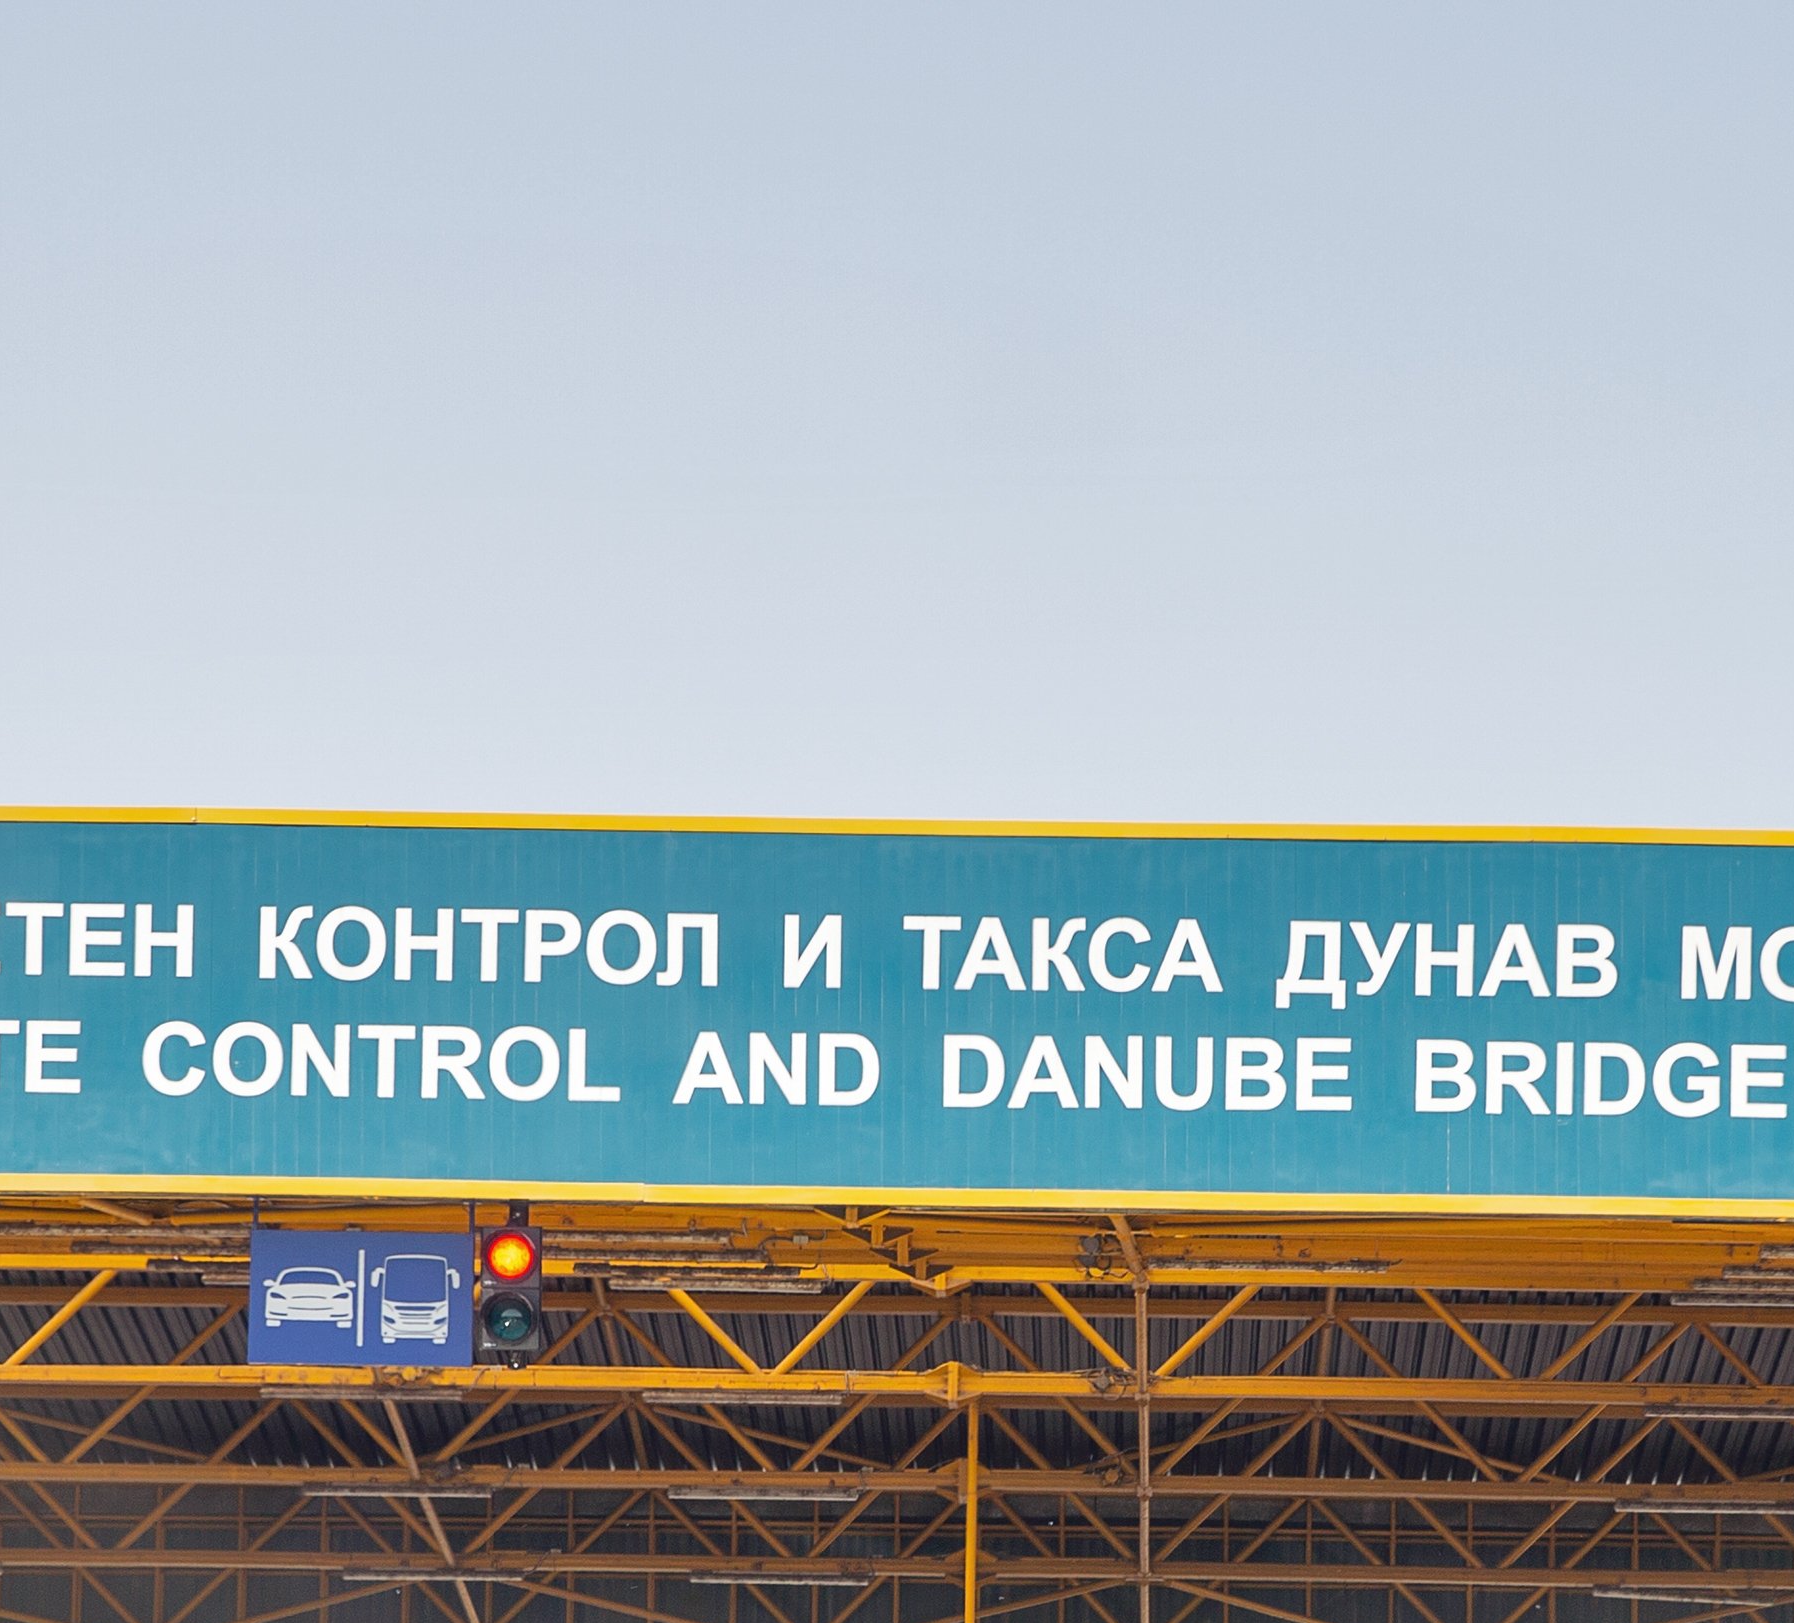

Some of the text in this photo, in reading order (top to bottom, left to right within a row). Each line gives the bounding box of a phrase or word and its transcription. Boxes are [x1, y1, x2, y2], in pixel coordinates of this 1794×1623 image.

[257, 905, 720, 987] КОНТРОЛ
[782, 914, 843, 989] И
[902, 915, 1225, 993] ТАКСА
[1275, 920, 1619, 1010] ДУНАВ
[142, 1020, 621, 1104] CONTROL
[672, 1031, 881, 1107] AND
[942, 1034, 1354, 1112] DANUBE
[1414, 1038, 1789, 1119] BRIDGE
